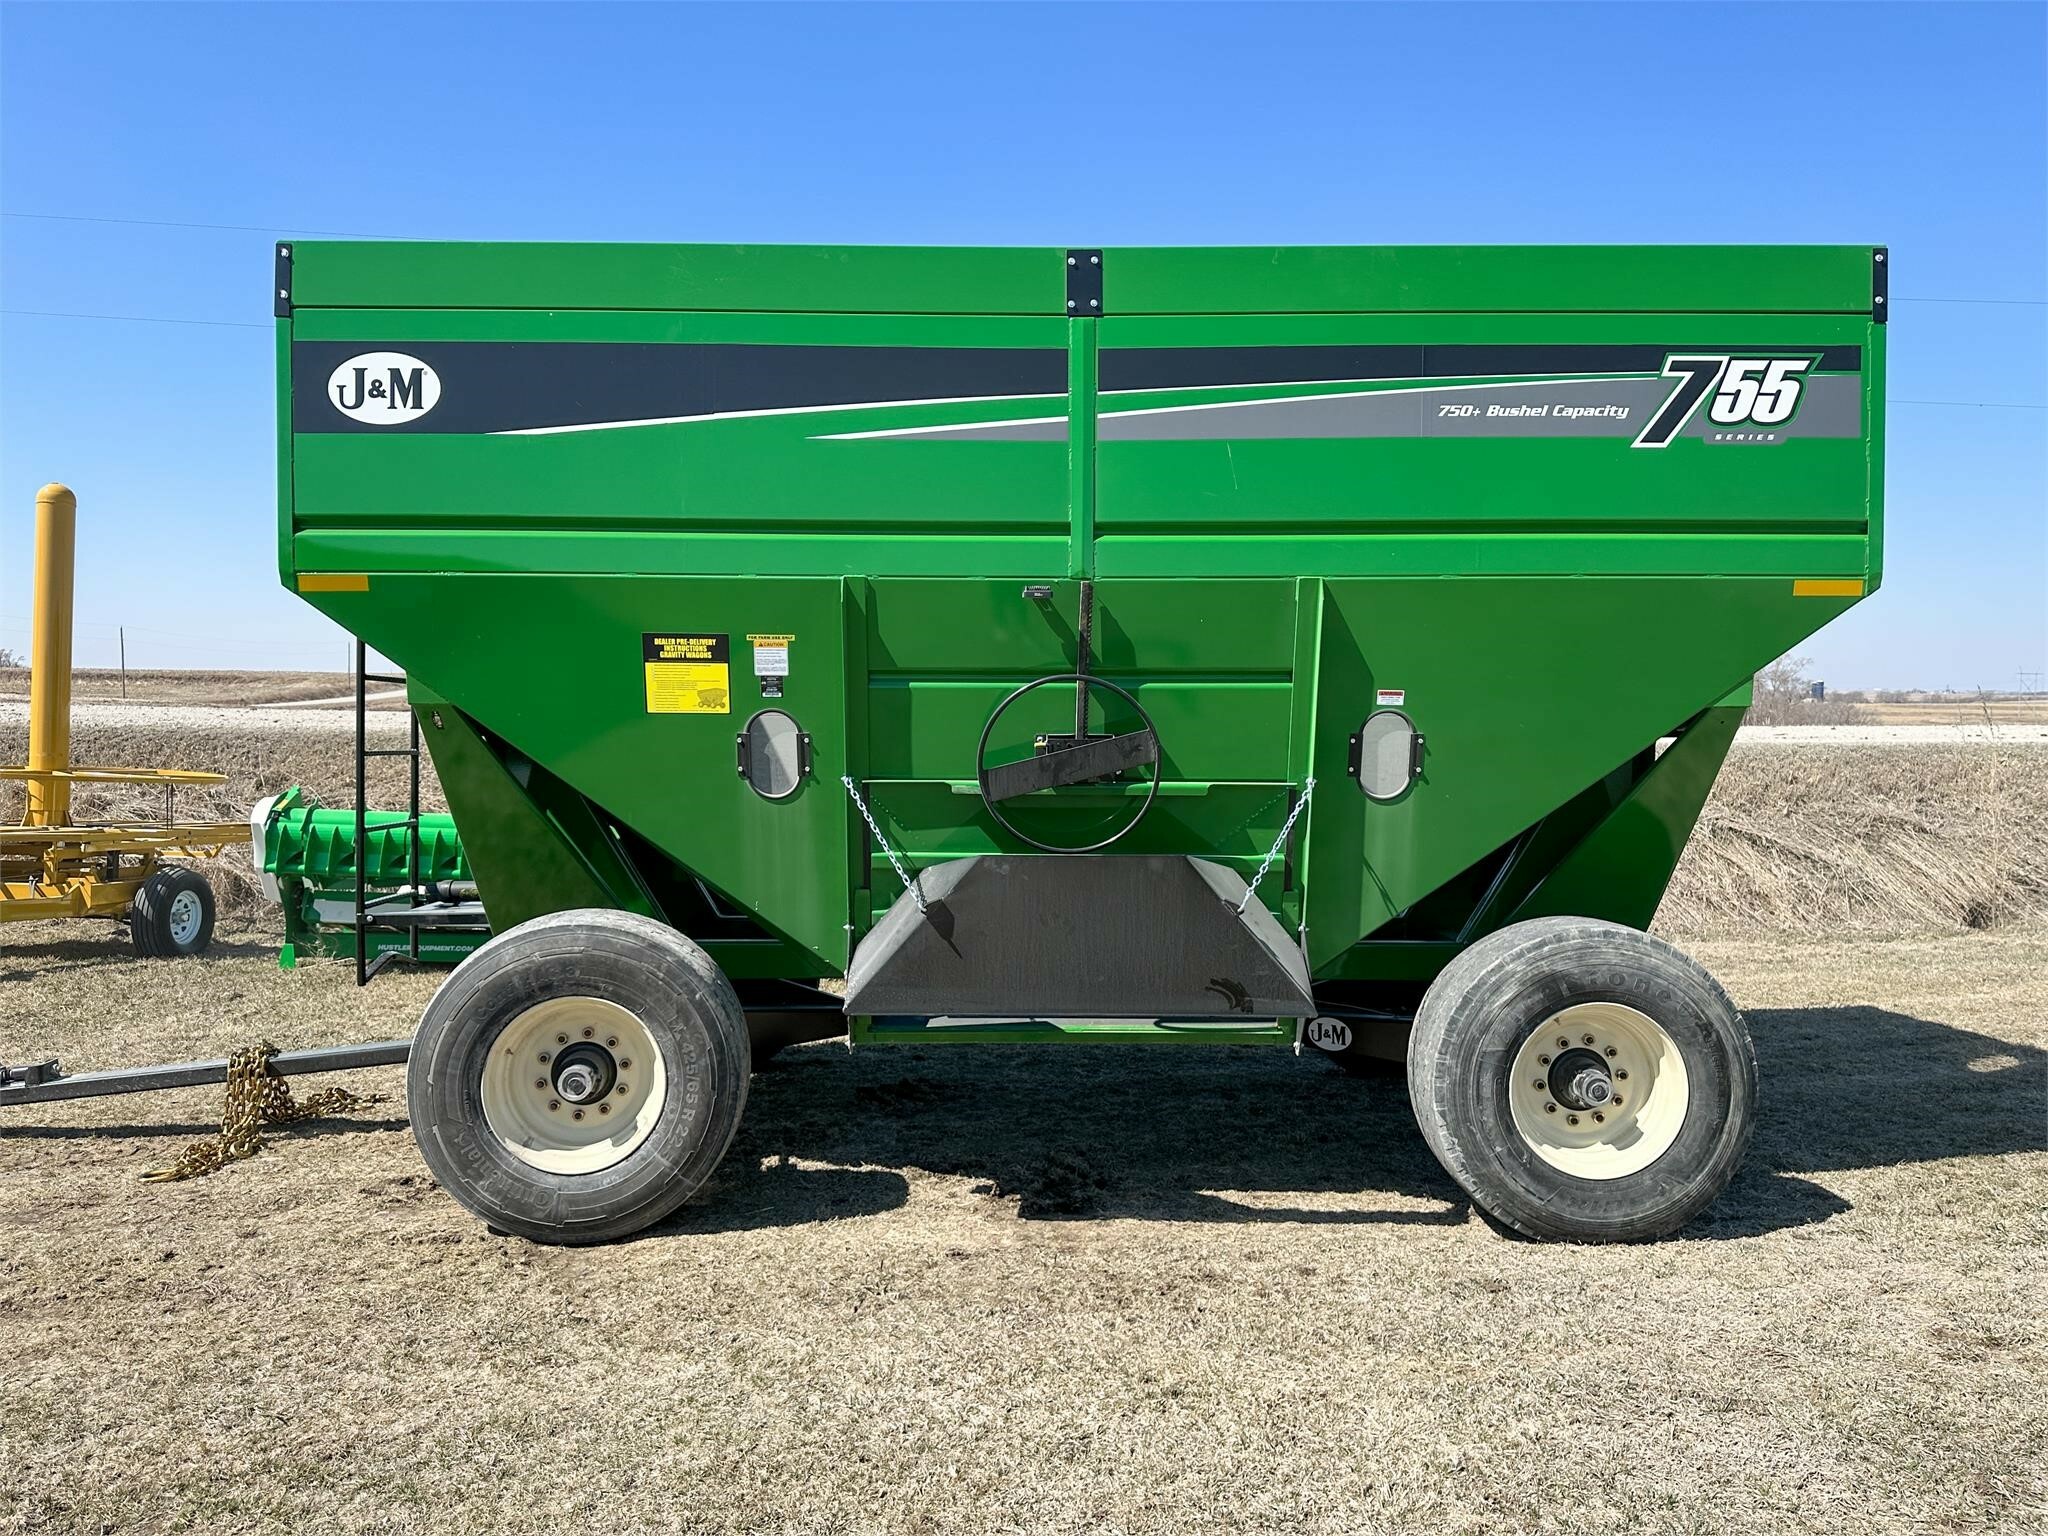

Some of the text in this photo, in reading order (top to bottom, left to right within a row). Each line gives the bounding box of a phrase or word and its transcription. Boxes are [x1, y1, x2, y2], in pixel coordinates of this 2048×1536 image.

[336, 367, 425, 410] J&M
[1630, 355, 1812, 448] 755
[1438, 404, 1630, 420] 750+ Bushel Capacity
[1714, 433, 1776, 441] SERIES
[654, 638, 717, 646] DEALER PRE-DELIVERY
[660, 651, 712, 659] GRAVITY WAGONS
[1310, 1022, 1347, 1046] J&M
